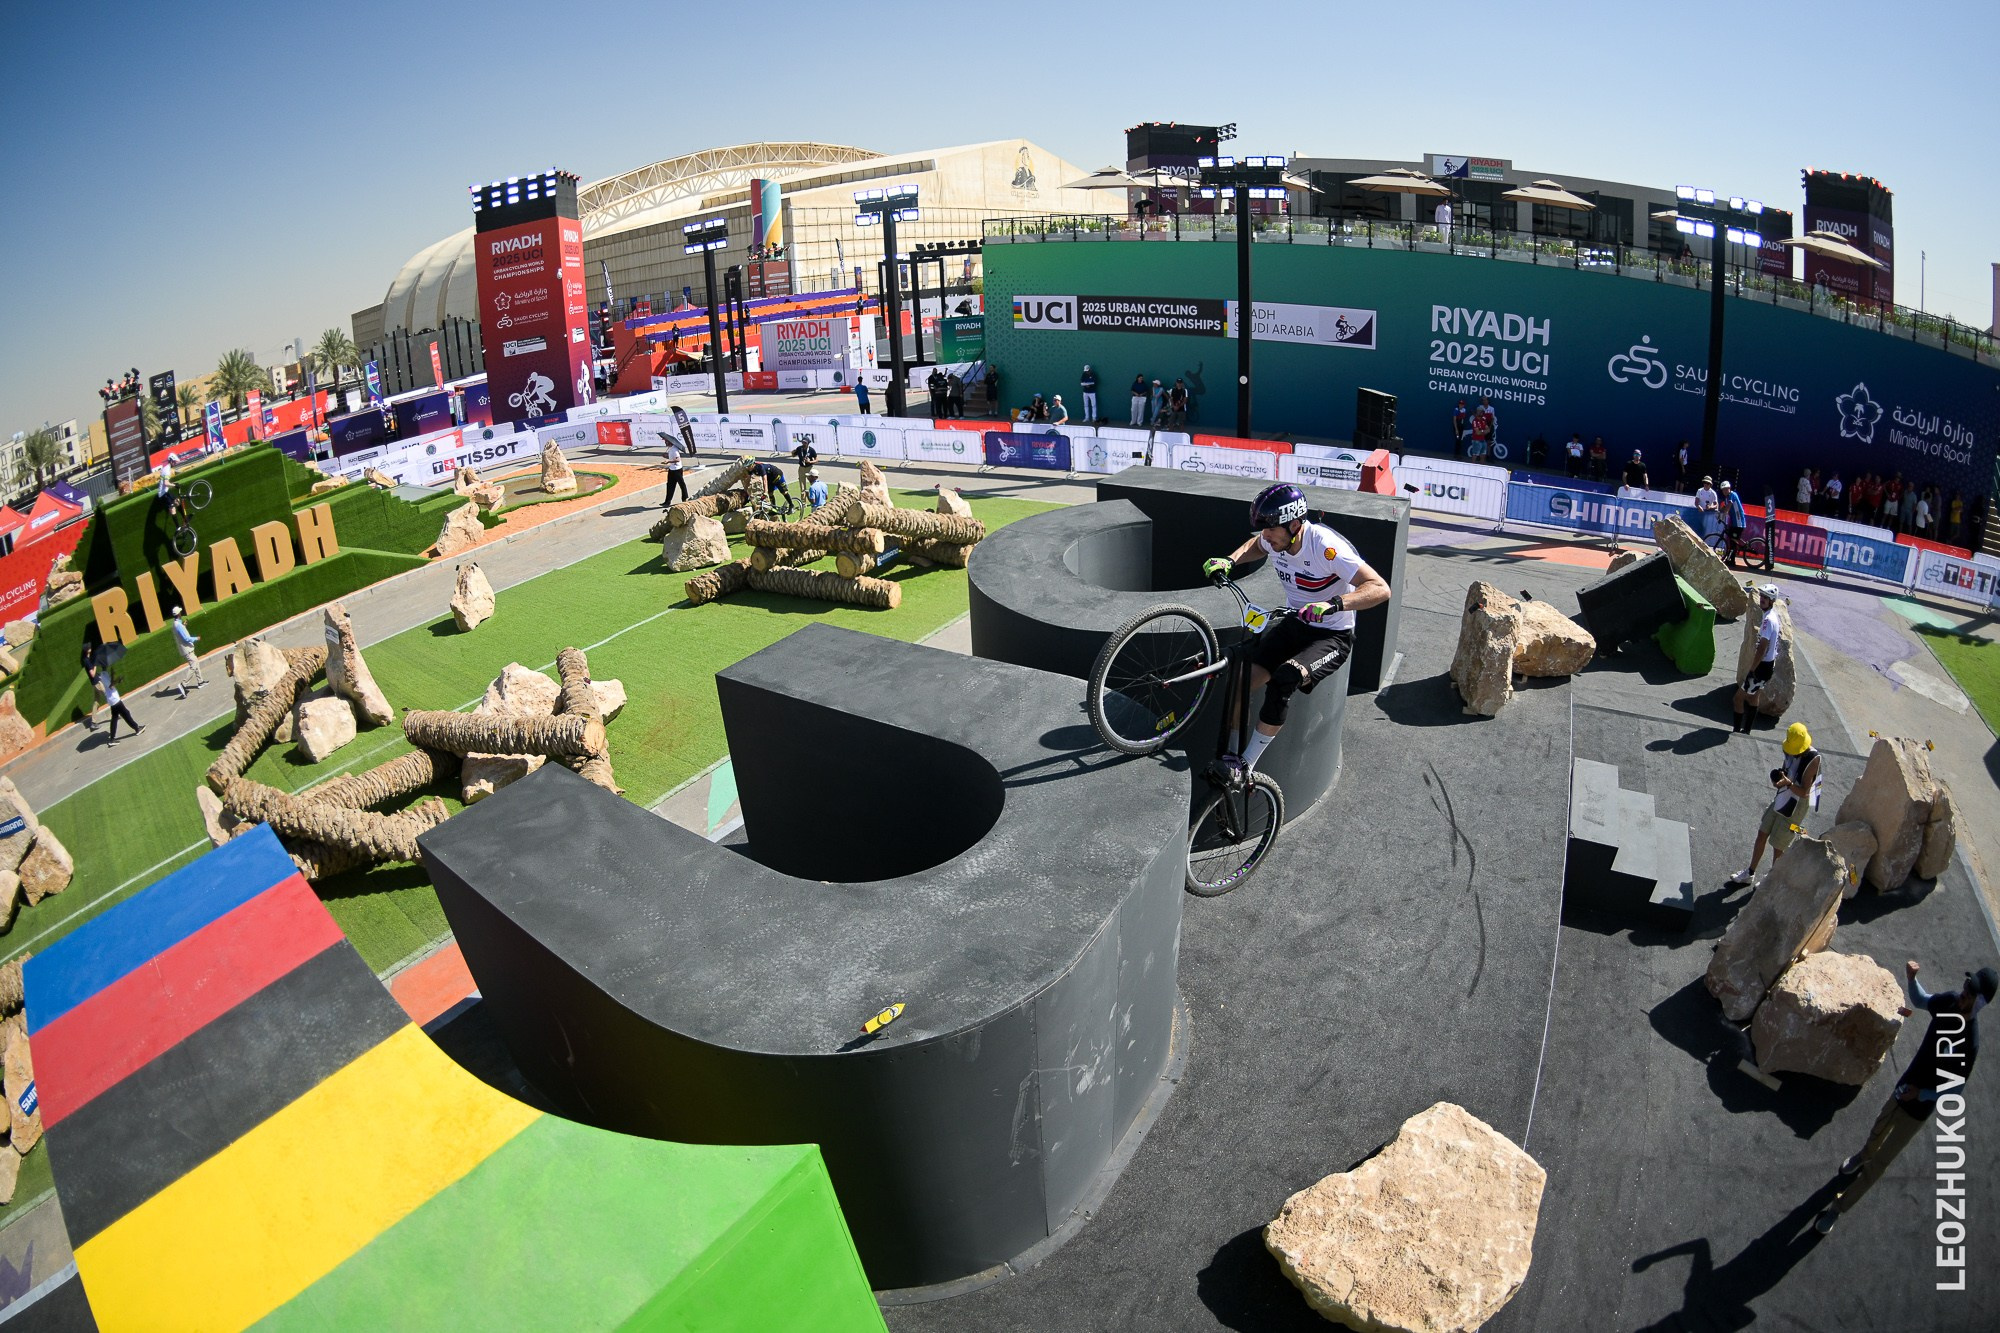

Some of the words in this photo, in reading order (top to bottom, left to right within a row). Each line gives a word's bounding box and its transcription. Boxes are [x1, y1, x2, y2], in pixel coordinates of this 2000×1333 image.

[1471, 158, 1504, 168] RIYADH
[564, 229, 578, 243] RIYADH
[1816, 220, 1857, 237] RIYADH
[492, 232, 542, 255] RIYADH
[1761, 240, 1785, 253] YADH
[1874, 230, 1890, 249] RIYADH
[492, 254, 520, 267] 2025
[523, 248, 543, 261] UCI
[494, 265, 509, 274] URBAN
[509, 262, 528, 272] CYCLING
[528, 260, 544, 268] WORLD
[494, 266, 545, 281] CHAMPIONSHIPS
[1024, 302, 1072, 324] UCI
[1082, 302, 1105, 312] 2025
[1109, 303, 1146, 314] URBAN
[1148, 304, 1198, 315] CYCLING
[1234, 307, 1276, 320] RADH
[777, 321, 830, 340] RIYADH
[956, 322, 980, 330] RIYADH
[1083, 314, 1121, 326] WORLD
[1124, 316, 1221, 331] CHAMPIONSHIPS
[1234, 323, 1269, 334] SUDI
[1272, 324, 1315, 337] ARABIA
[1431, 304, 1550, 346] RIYADH
[778, 339, 805, 352] 2025
[809, 338, 831, 350] UCI
[1430, 340, 1495, 368] 2025
[1502, 348, 1549, 376] UCI
[1429, 367, 1464, 379] URBAN
[1466, 372, 1509, 384] CYCLING
[1511, 378, 1547, 391] WORLD
[1675, 364, 1725, 386] SAUI
[1732, 376, 1799, 402] CYCLING
[1428, 380, 1546, 406] CHAMPIONSHIPS
[678, 413, 684, 422] 5
[1892, 405, 1940, 435] الرياضة
[1943, 420, 1974, 449] وزارة
[457, 442, 518, 468] TISSOT
[1890, 428, 1929, 455] Ministry
[1930, 444, 1942, 456] of
[1943, 444, 1971, 465] Sport
[1210, 463, 1232, 471] SAUDI
[1235, 465, 1267, 474] CYCLING
[1302, 467, 1318, 475] UCI
[1432, 484, 1465, 500] UCI
[1279, 497, 1306, 514] TRIAL
[1550, 497, 1681, 529] SHIMAN
[1768, 499, 1772, 512] 3
[1279, 508, 1307, 524] BIKES
[92, 502, 341, 646] RIYADH
[6, 579, 36, 600] CYCLING
